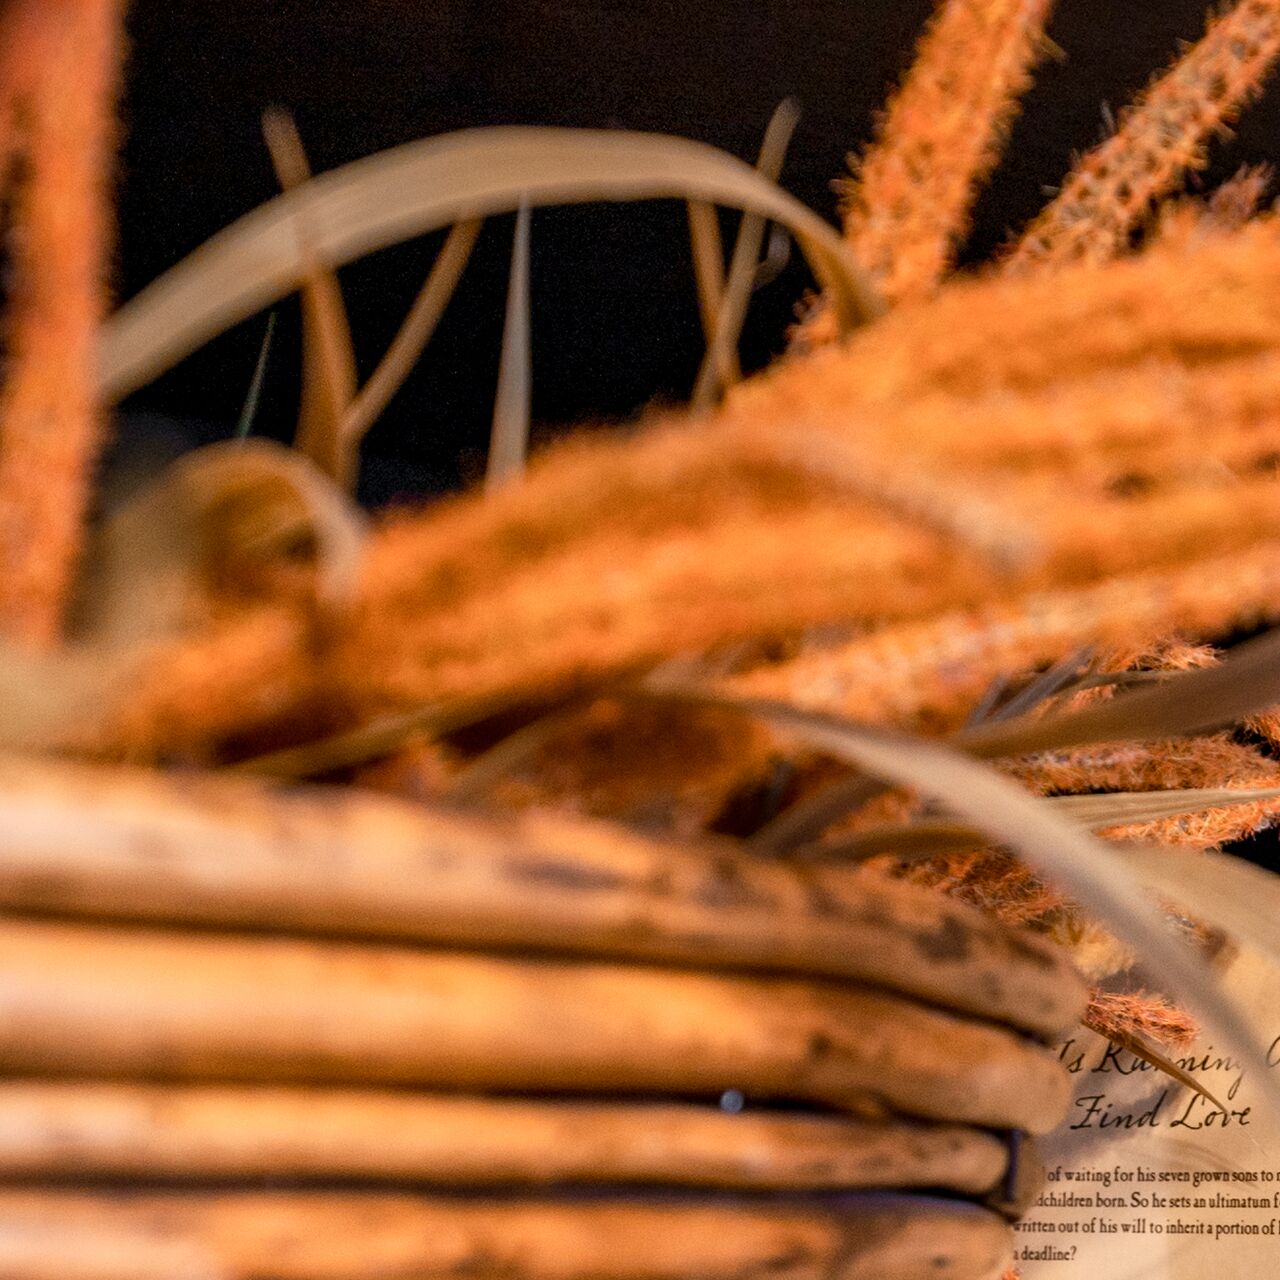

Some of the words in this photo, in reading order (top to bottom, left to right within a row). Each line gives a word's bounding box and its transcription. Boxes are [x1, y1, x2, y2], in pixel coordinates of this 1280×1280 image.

[1070, 1090, 1166, 1130] Find
[1170, 1093, 1250, 1130] Love
[1065, 1167, 1111, 1187] waiting
[1113, 1166, 1134, 1182] for
[1137, 1166, 1156, 1182] his
[1158, 1171, 1190, 1183] seven
[1192, 1171, 1230, 1187] grown
[1232, 1171, 1258, 1183] sons
[1096, 1192, 1128, 1208] born.
[1130, 1192, 1149, 1208] So
[1208, 1193, 1271, 1208] ultimatum
[1013, 1218, 1056, 1233] written
[1058, 1221, 1079, 1233] out
[1099, 1218, 1118, 1234] his
[1121, 1218, 1146, 1234] will
[1166, 1218, 1204, 1235] inherit
[1215, 1219, 1259, 1240] portion
[1021, 1245, 1077, 1261] deadline?
